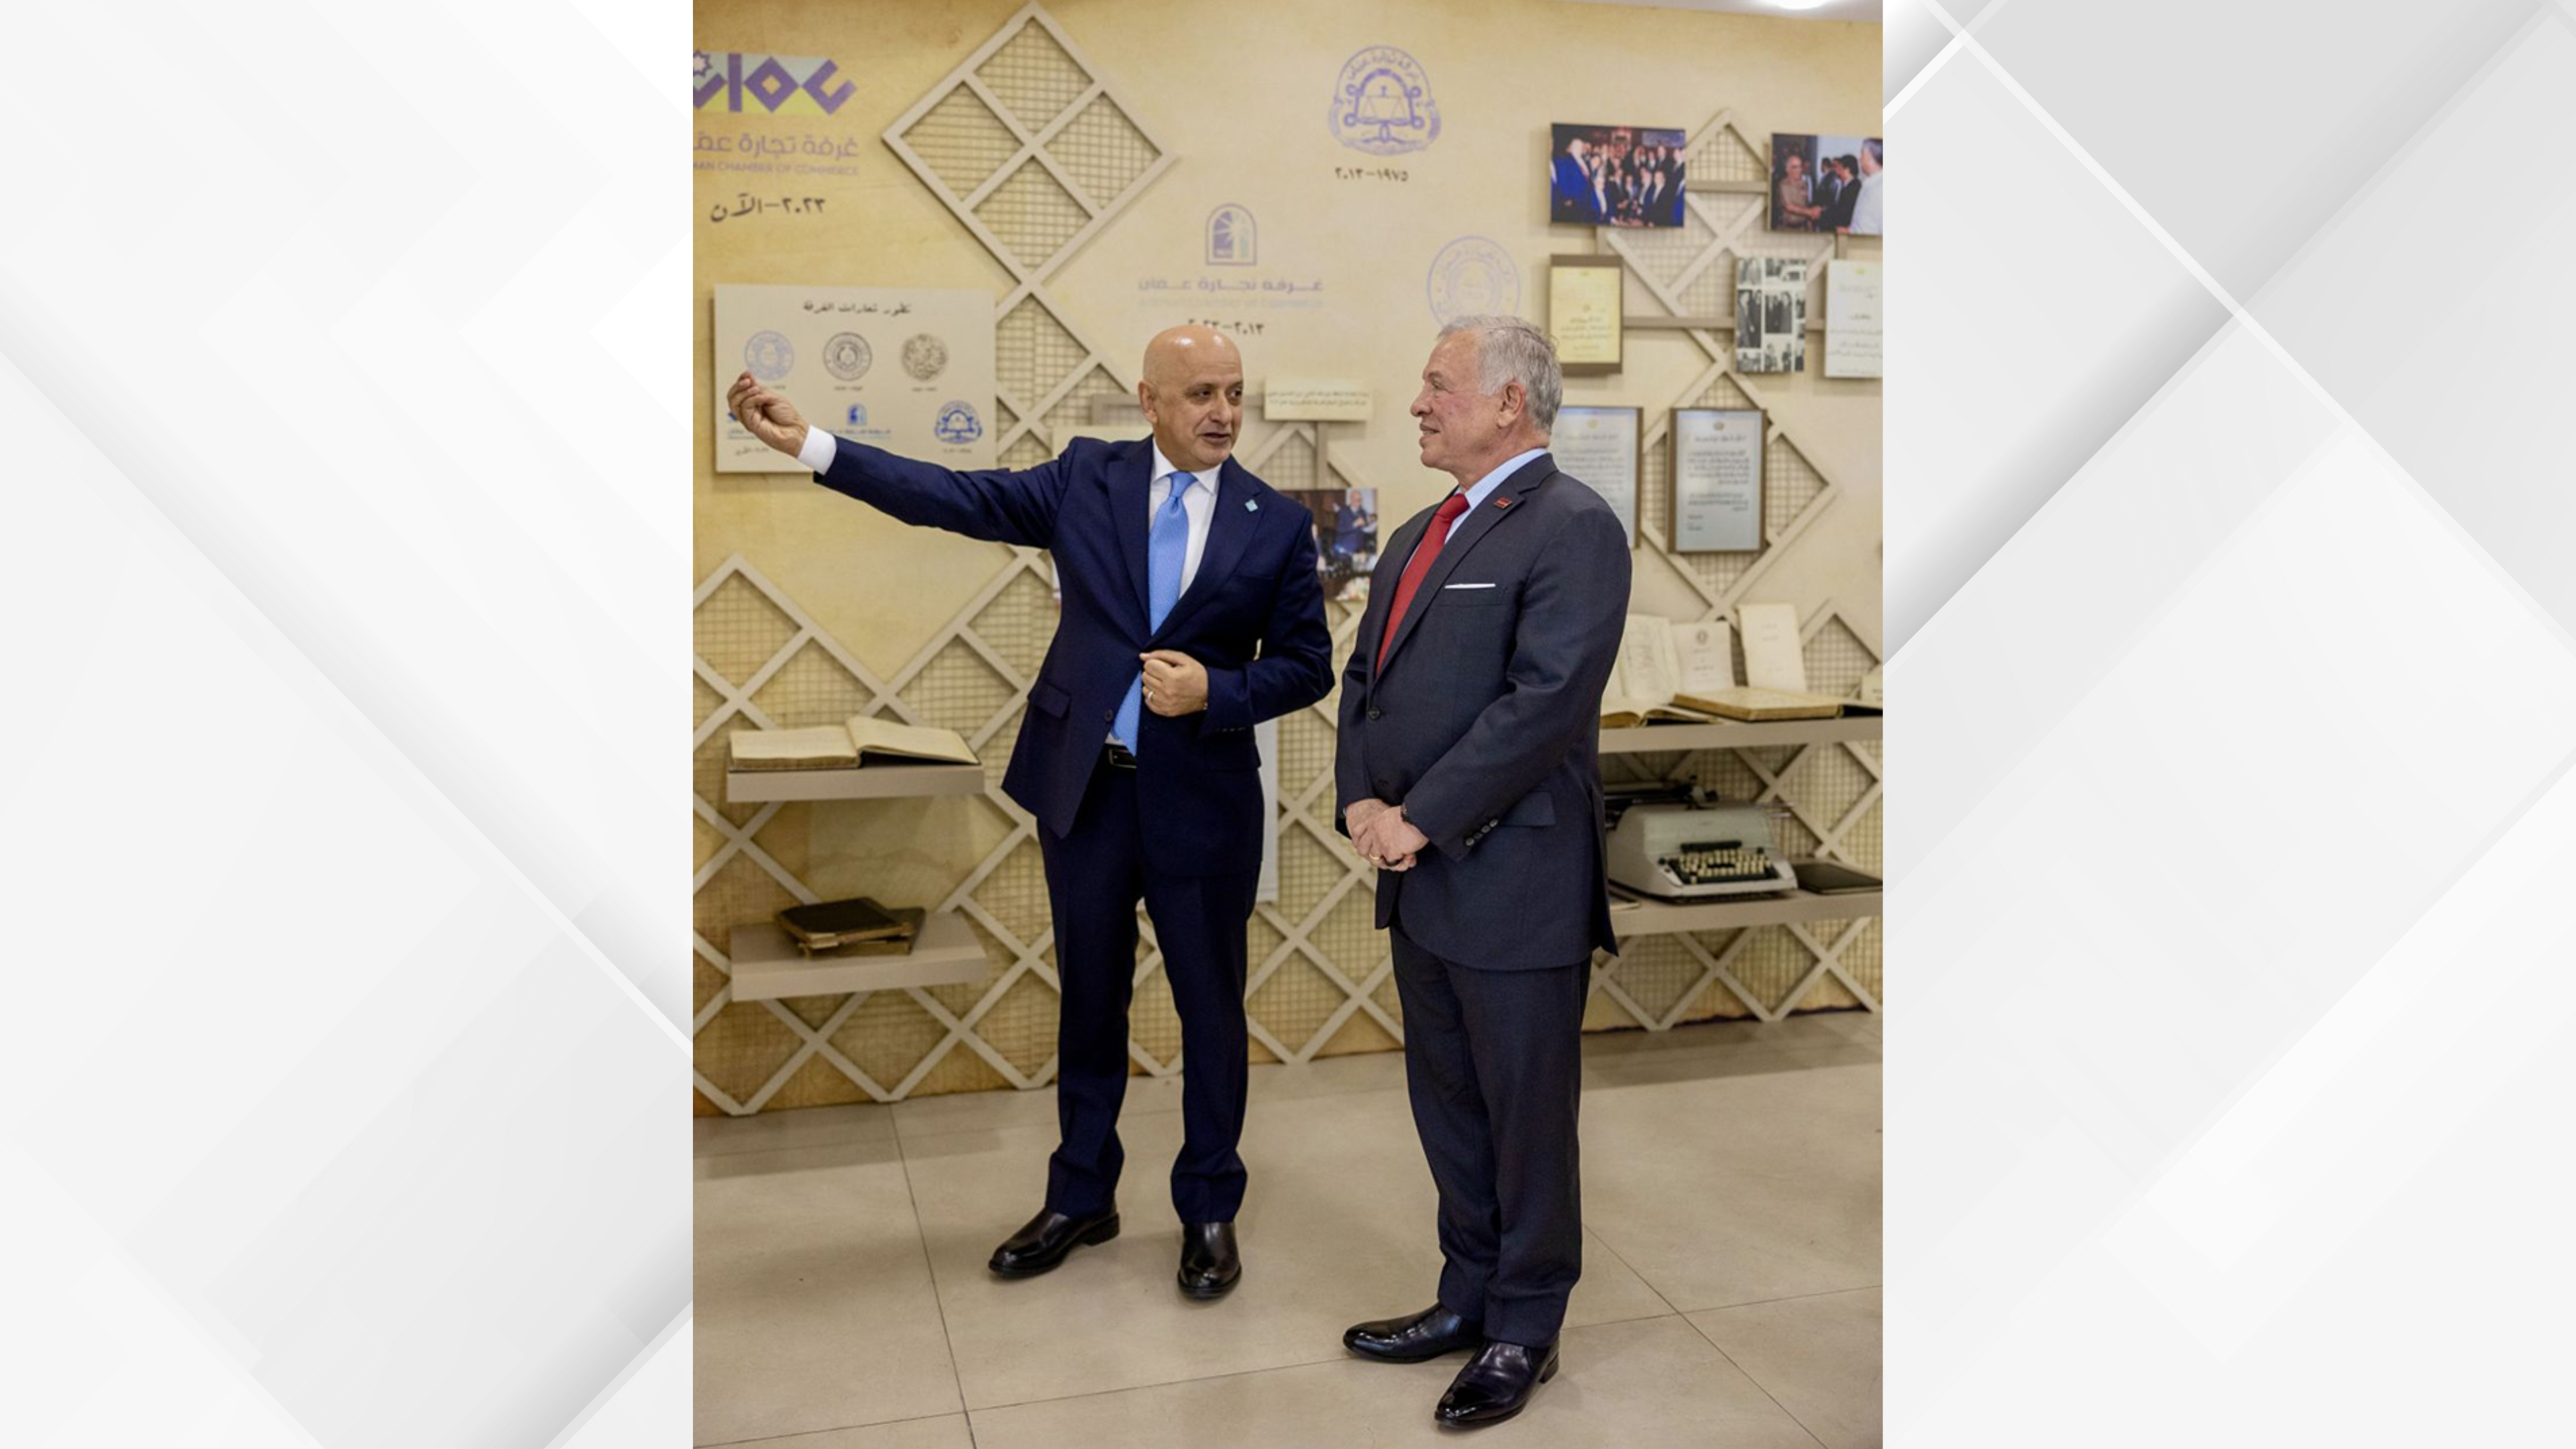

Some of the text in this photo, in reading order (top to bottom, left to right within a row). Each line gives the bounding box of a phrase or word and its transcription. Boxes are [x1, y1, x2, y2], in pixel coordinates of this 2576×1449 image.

[738, 133, 796, 160] تجارة
[802, 134, 859, 162] غرفة
[693, 162, 714, 170] MAN
[775, 164, 791, 172] OF
[794, 164, 859, 176] COMMERCE
